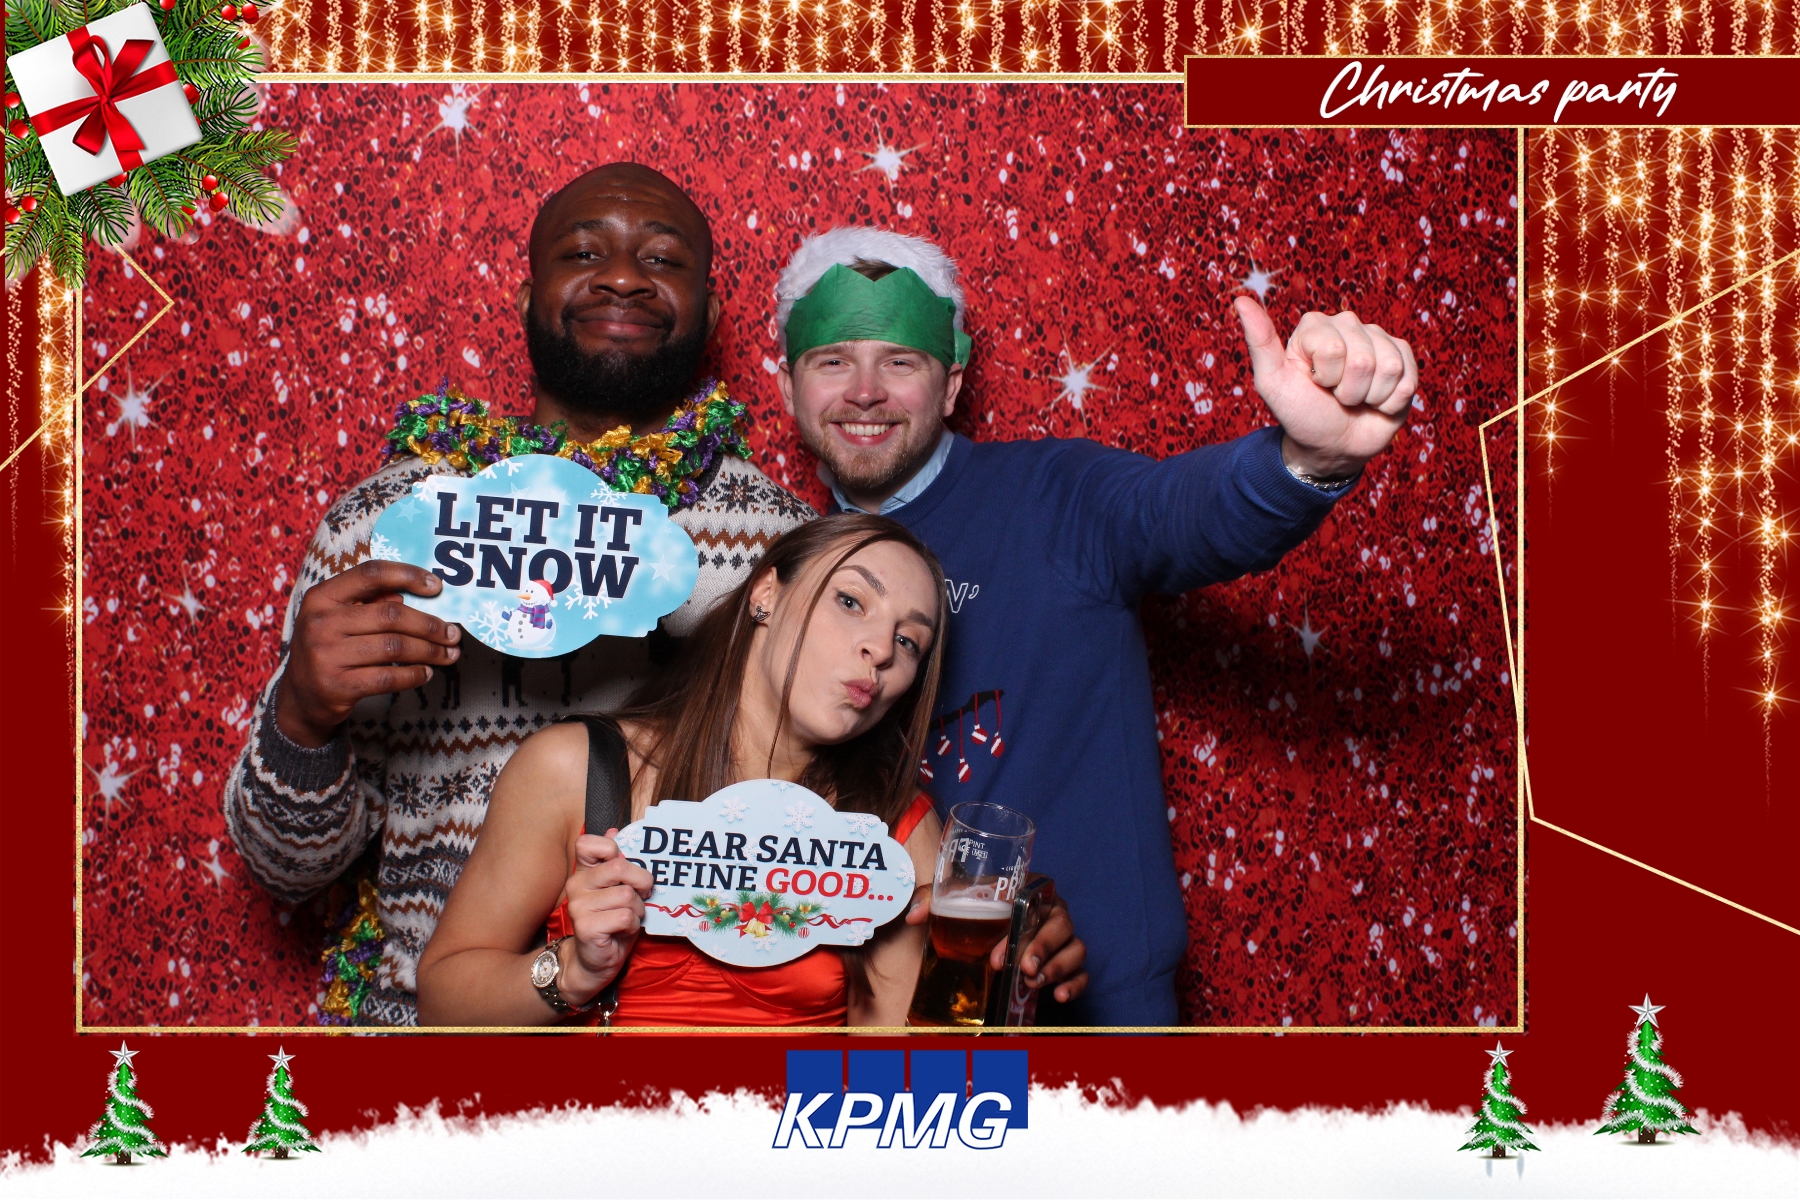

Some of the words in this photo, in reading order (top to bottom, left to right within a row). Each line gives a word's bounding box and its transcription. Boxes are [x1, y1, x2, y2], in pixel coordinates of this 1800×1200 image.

[434, 491, 559, 545] LET
[574, 504, 642, 552] IT
[432, 540, 640, 598] SNOW
[640, 826, 748, 861] DEAR
[757, 834, 888, 871] SANTA
[765, 868, 894, 902] GOOD...
